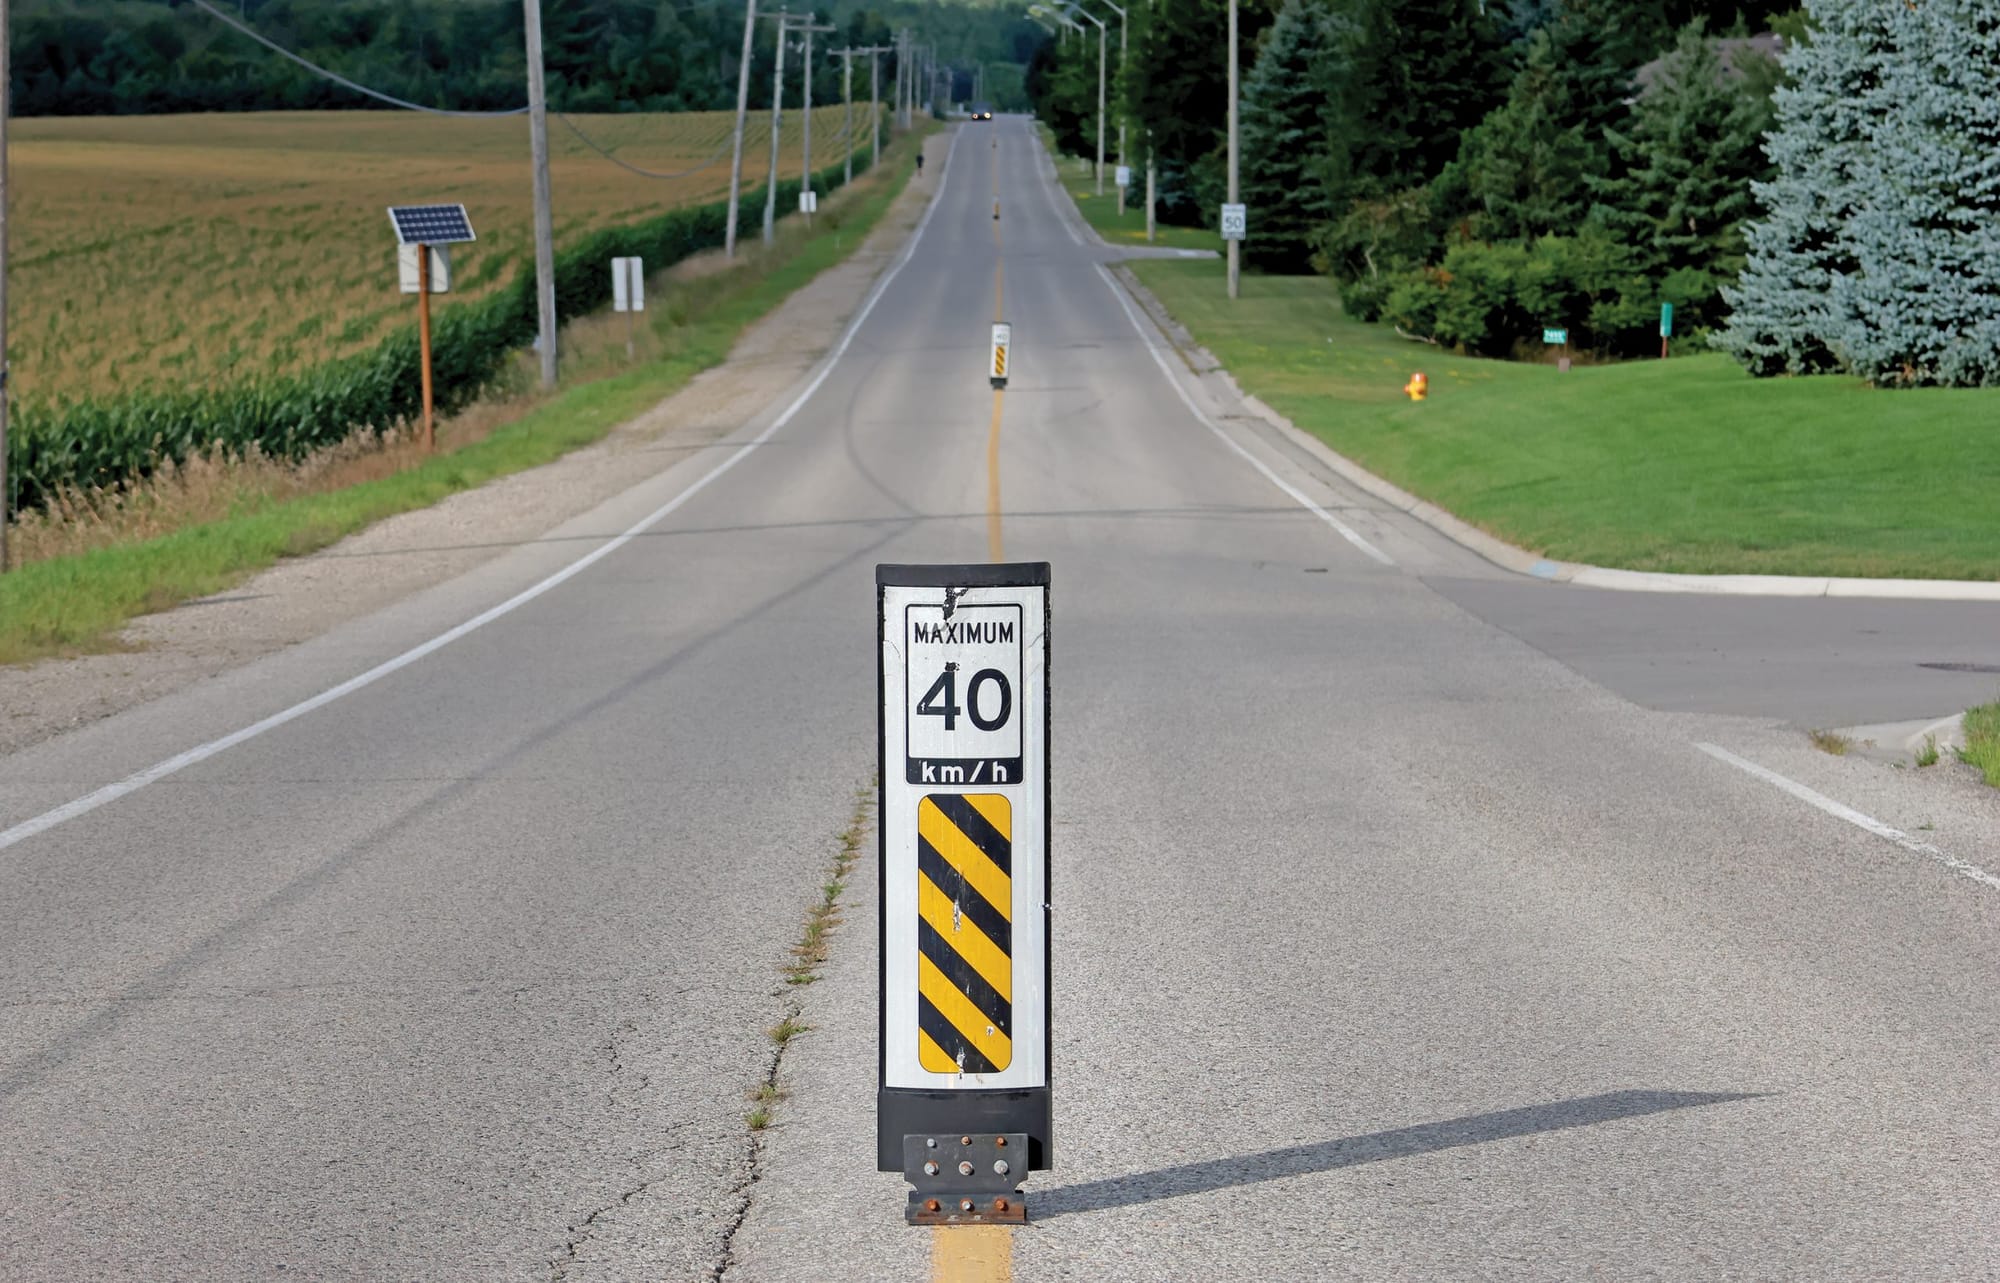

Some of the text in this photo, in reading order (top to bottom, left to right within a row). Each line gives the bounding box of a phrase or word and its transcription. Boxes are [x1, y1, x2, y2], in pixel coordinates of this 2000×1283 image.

[1225, 215, 1242, 229] 50
[914, 622, 1013, 644] MAXIMUM
[916, 668, 1012, 731] 40
[921, 760, 1007, 783] km/h
